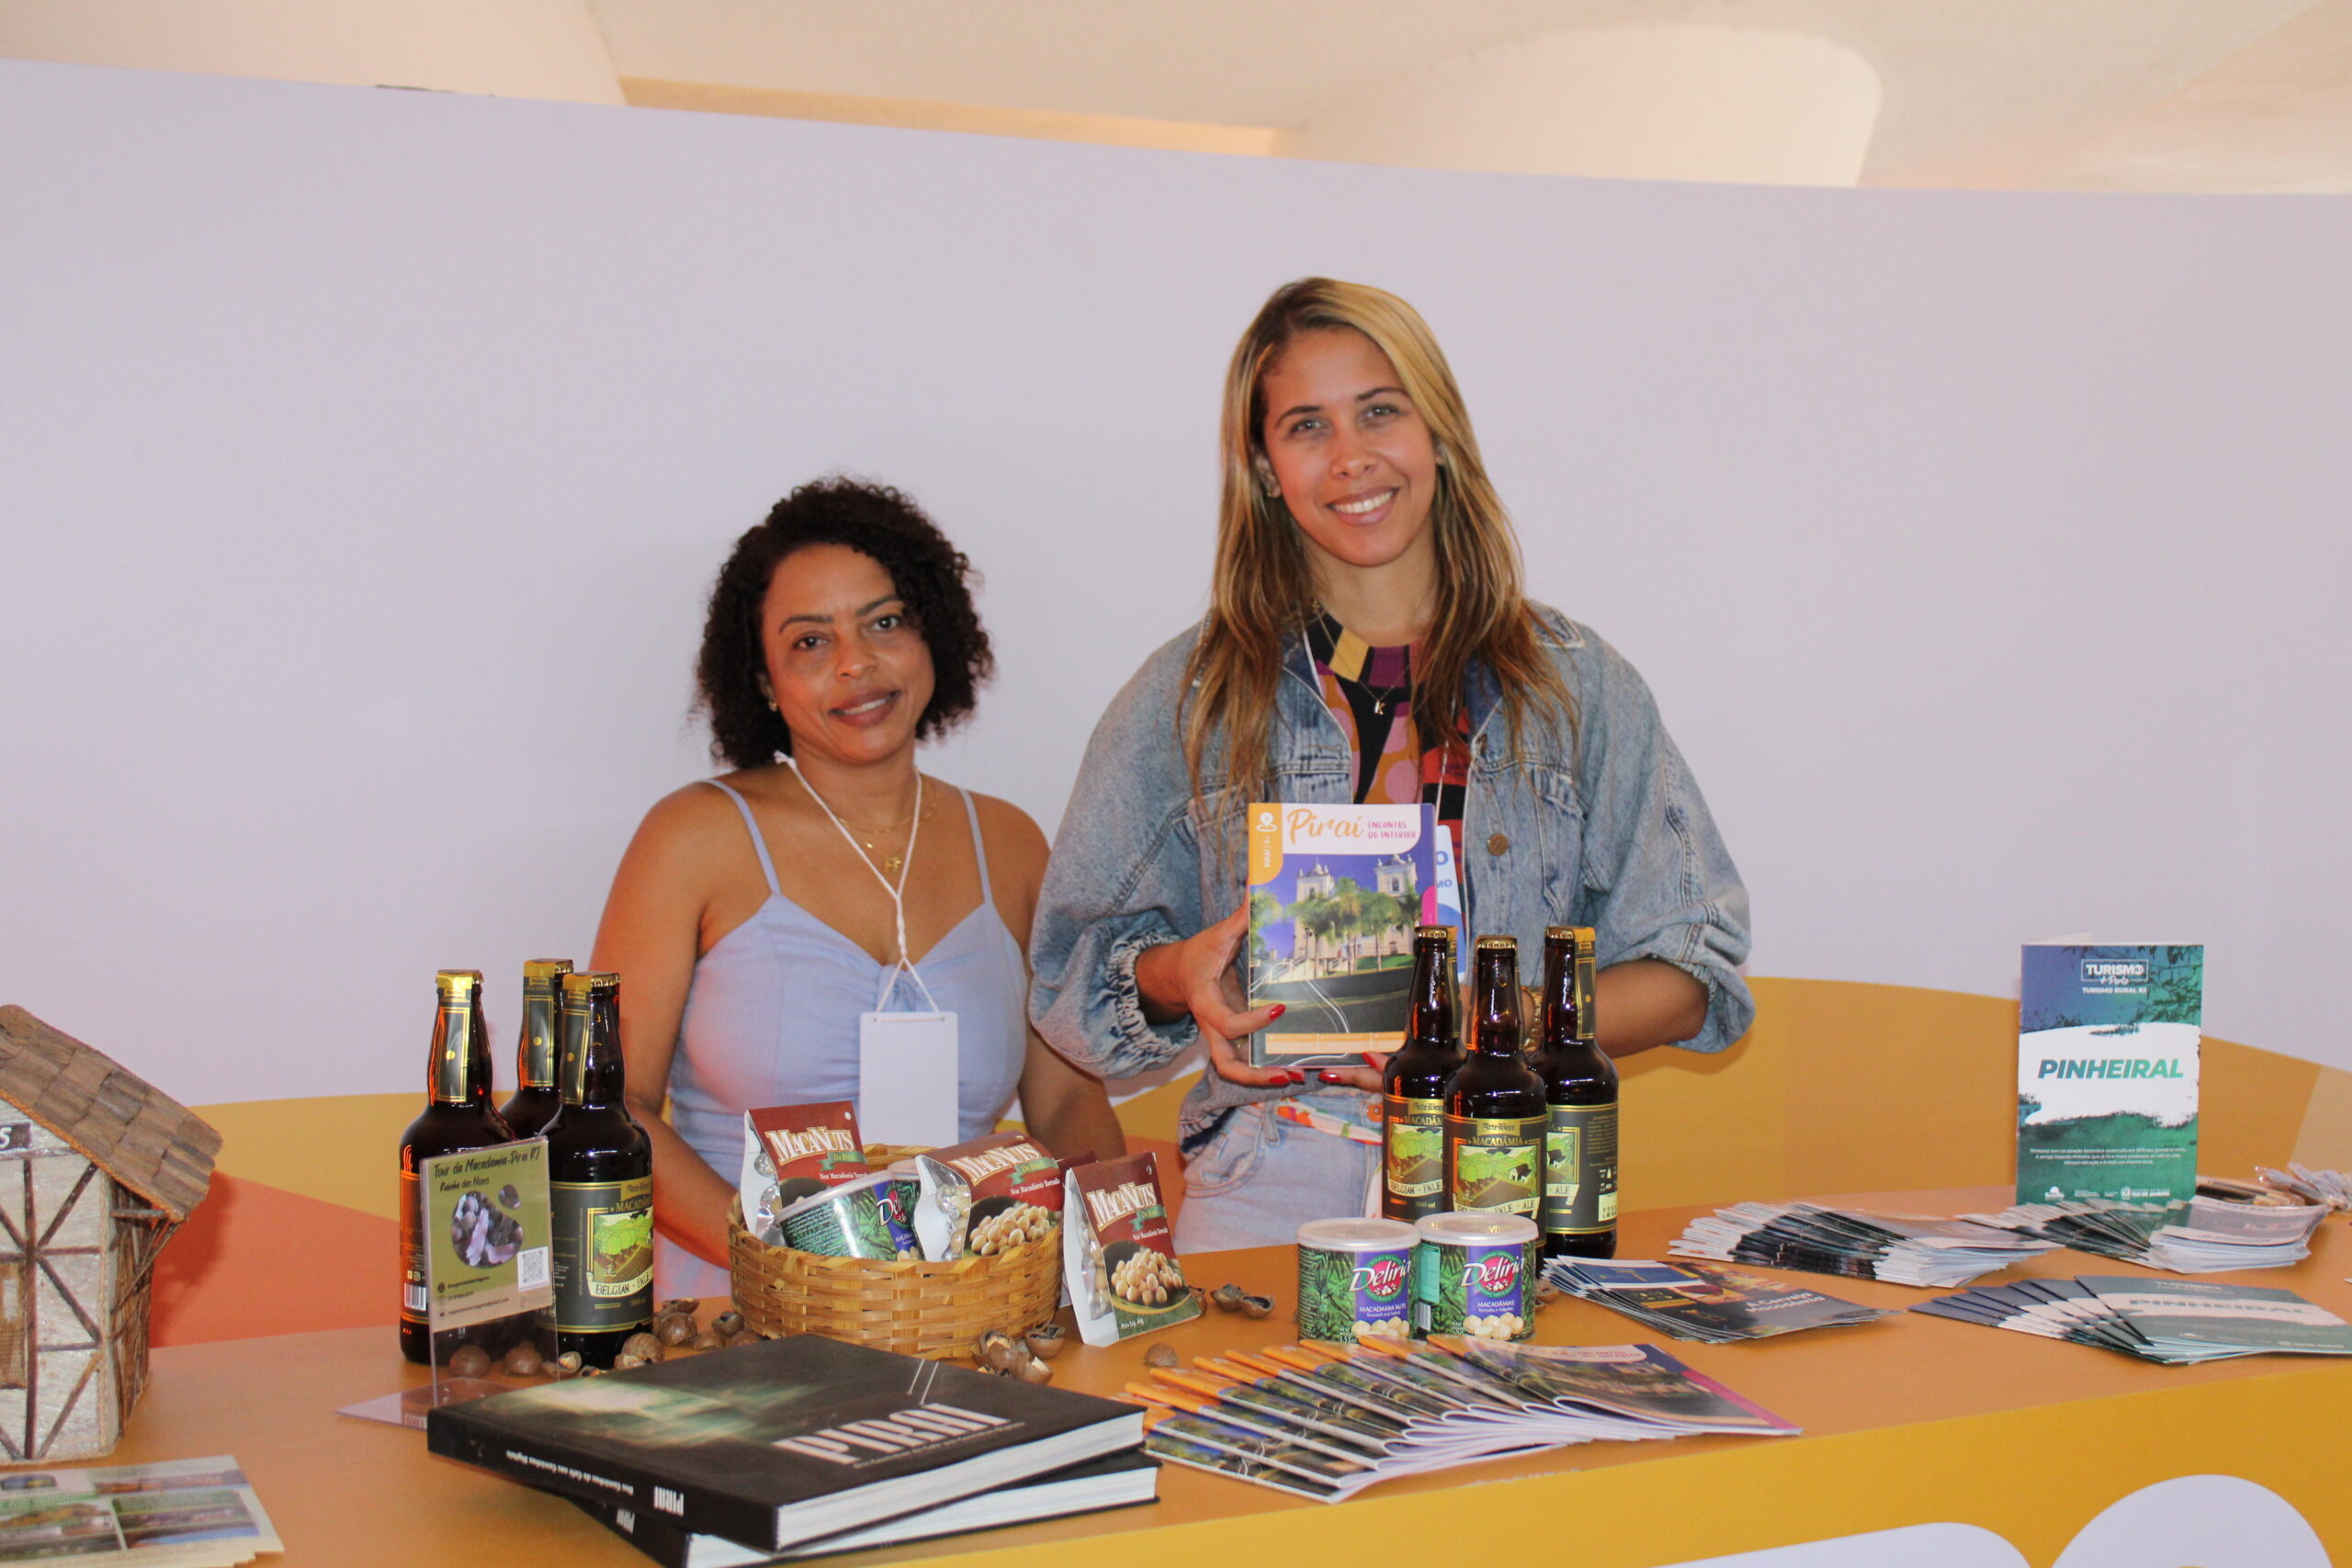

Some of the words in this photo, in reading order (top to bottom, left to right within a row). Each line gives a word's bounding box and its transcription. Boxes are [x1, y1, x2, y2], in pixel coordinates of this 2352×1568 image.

[1367, 820, 1407, 829] ENCANTOS
[1367, 830, 1378, 839] DO
[1381, 829, 1417, 839] INTERIOR
[2086, 964, 2144, 976] TURISMO
[2038, 1059, 2183, 1079] PINHEIRAL
[1472, 1135, 1523, 1146] MACADÂMIA
[434, 1162, 450, 1178] Tour
[453, 1162, 463, 1174] da
[461, 1179, 471, 1188] das
[1423, 1181, 1442, 1193] PALE
[1555, 1186, 1570, 1195] ALE
[1521, 1199, 1534, 1210] ALE
[595, 1282, 630, 1296] BELGIAN
